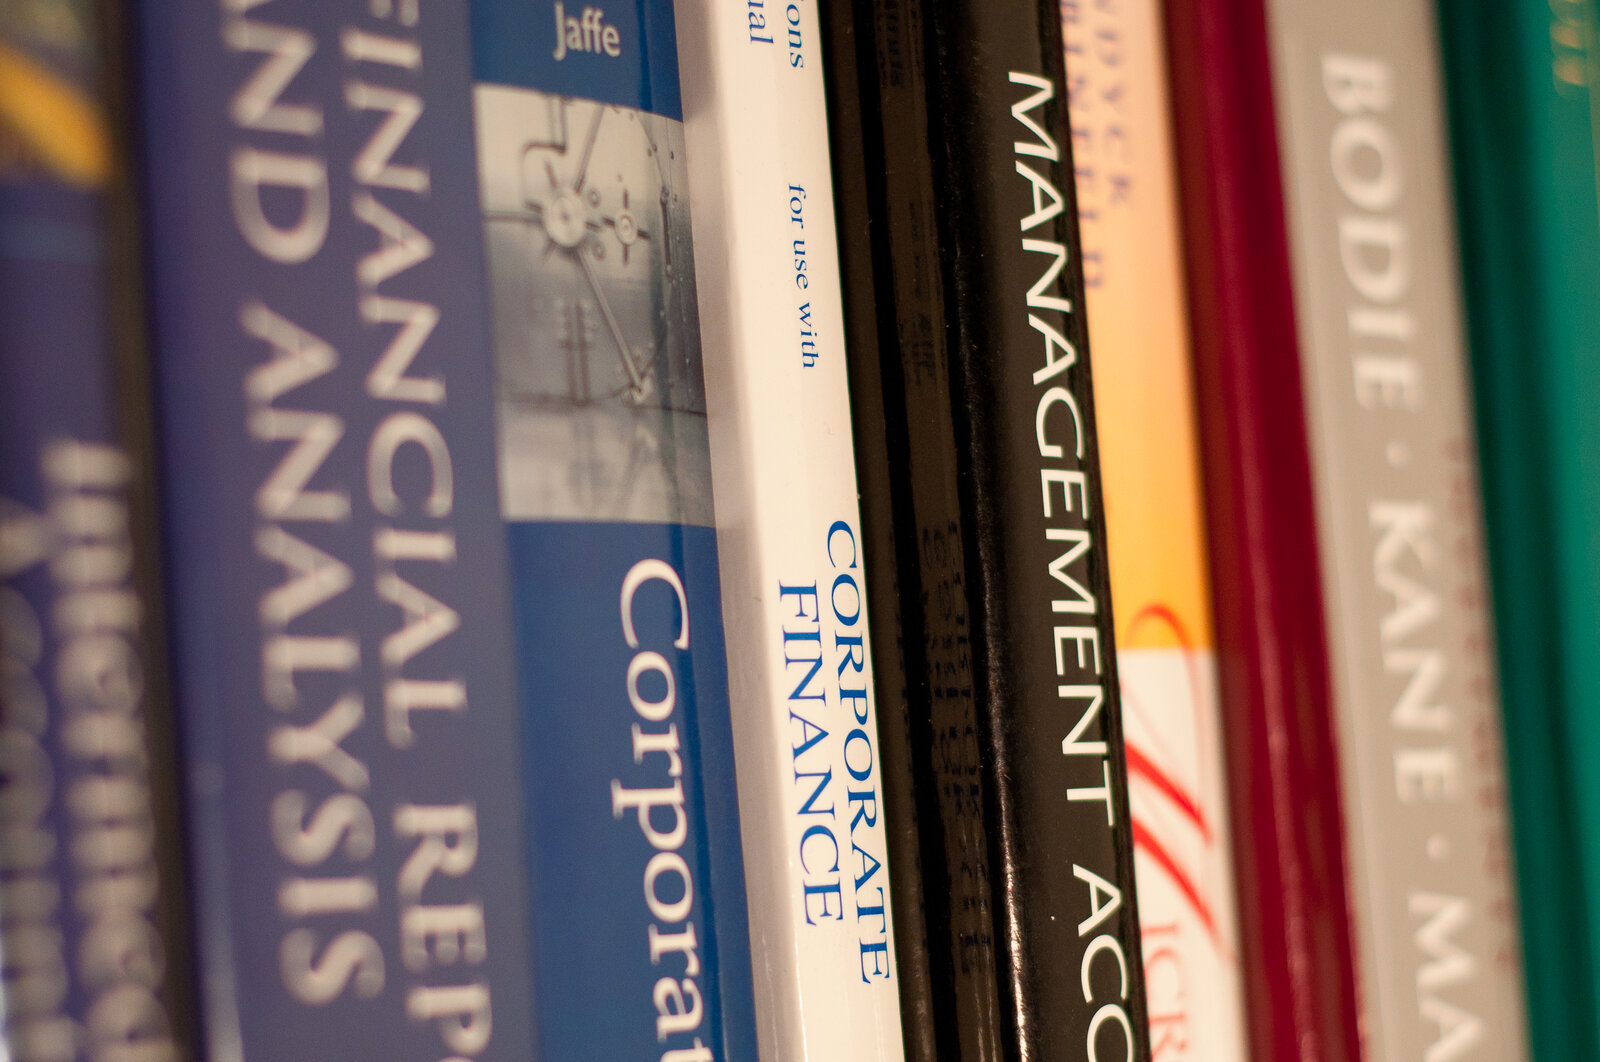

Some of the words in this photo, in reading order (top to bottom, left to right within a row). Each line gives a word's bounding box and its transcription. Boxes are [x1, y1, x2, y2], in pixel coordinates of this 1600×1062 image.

[222, 0, 330, 264] ND
[554, 1, 621, 61] Jaffe
[786, 0, 804, 68] ons
[788, 183, 806, 229] for
[792, 239, 809, 290] use
[798, 302, 819, 369] with
[1320, 53, 1421, 410] BODIE
[238, 301, 385, 1005] ANALYSIS
[1008, 71, 1115, 827] MANAGEMENT
[1073, 863, 1134, 1062] ACCO
[1368, 499, 1457, 800] KANE
[779, 579, 844, 926] FINANCE
[827, 520, 890, 984] CORPORATE
[393, 802, 492, 1062] REP
